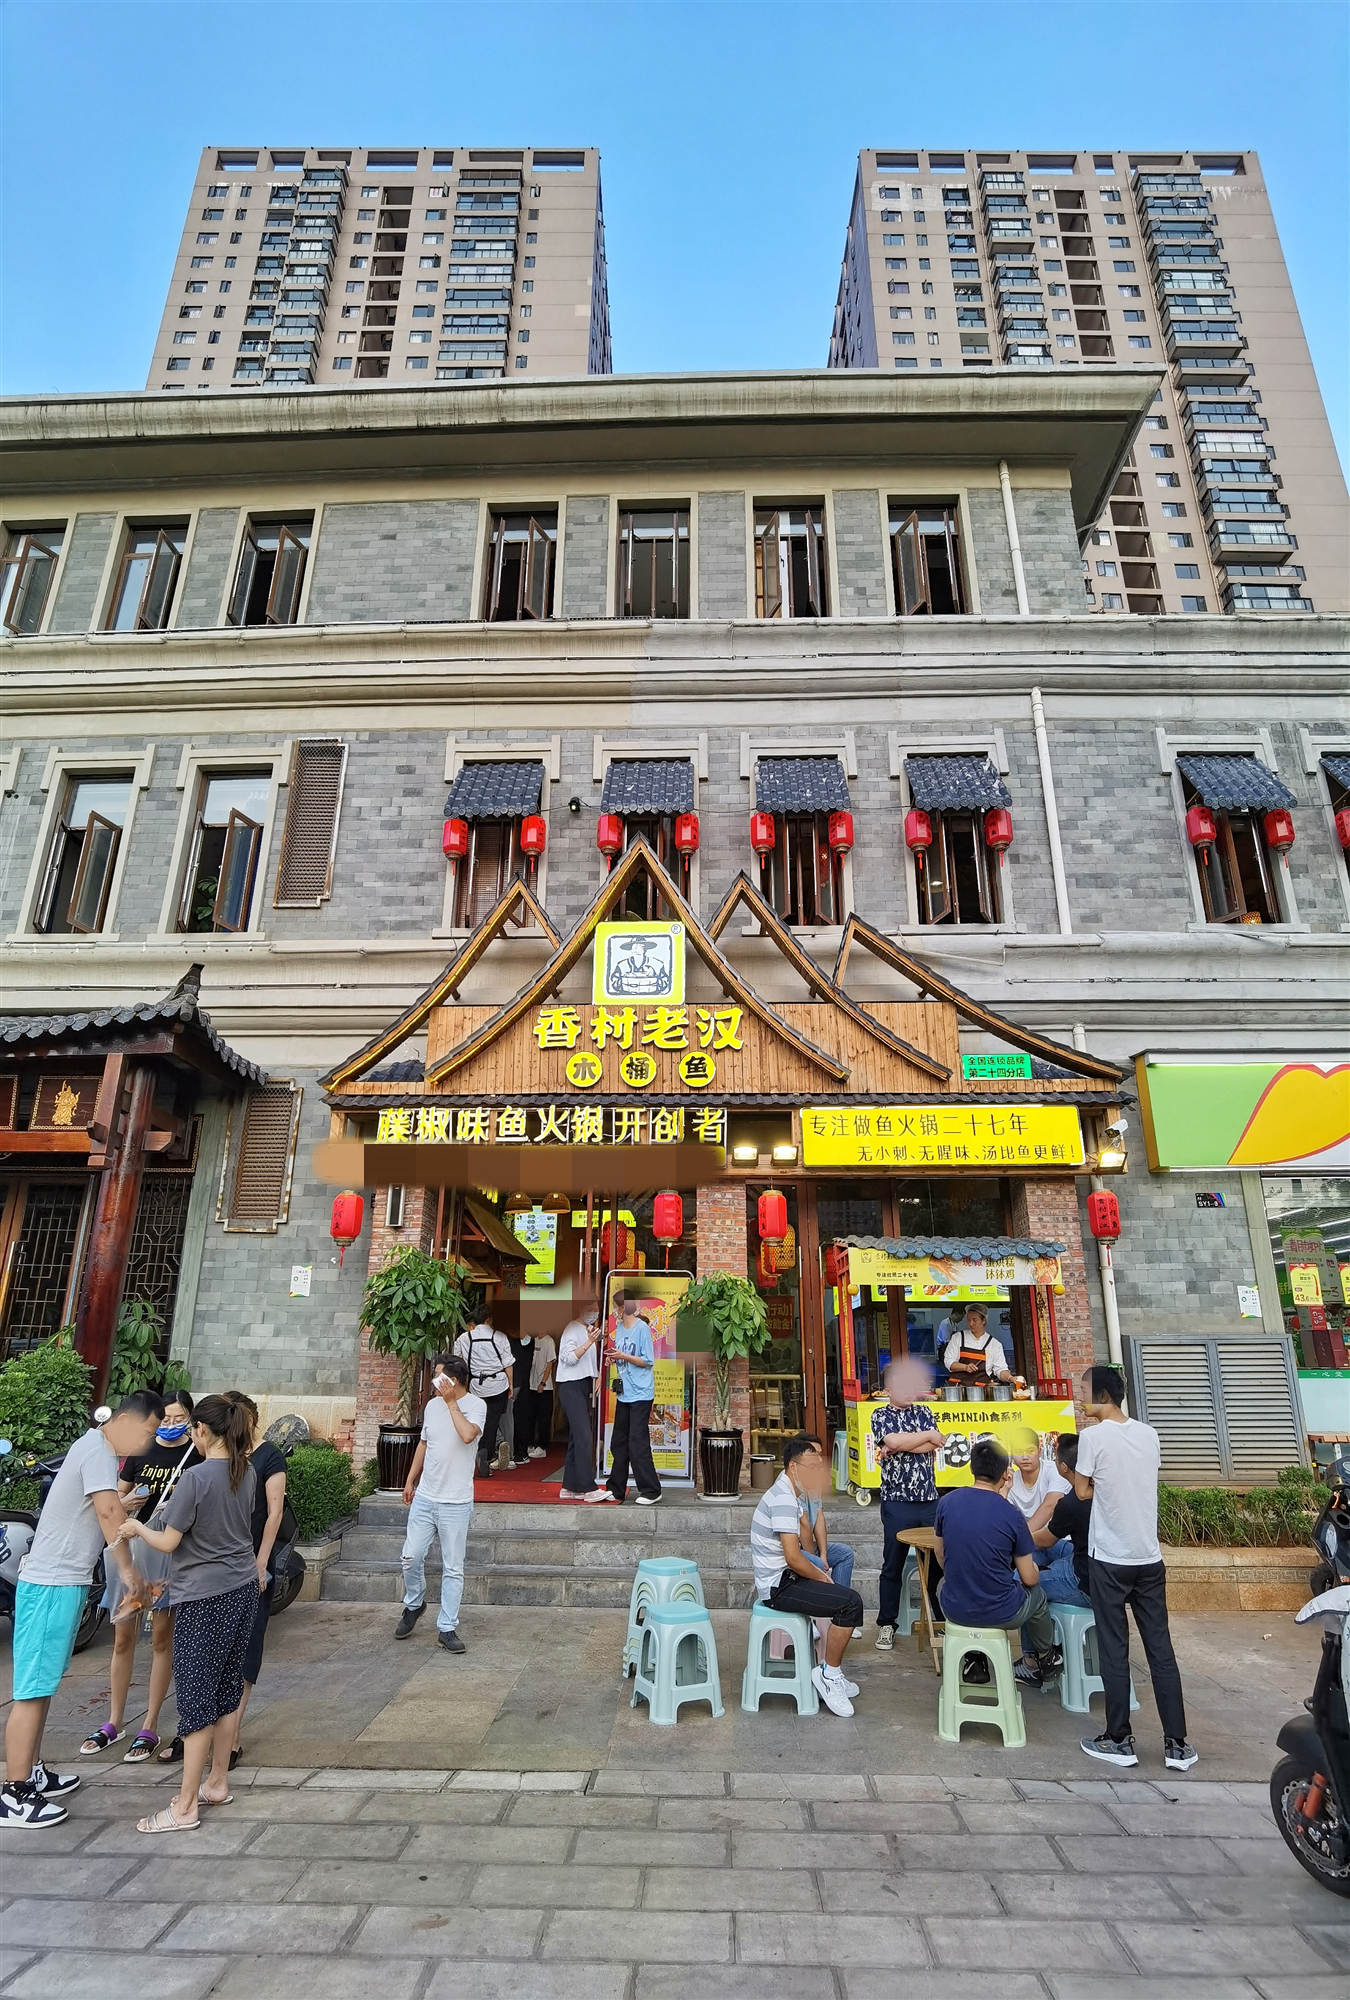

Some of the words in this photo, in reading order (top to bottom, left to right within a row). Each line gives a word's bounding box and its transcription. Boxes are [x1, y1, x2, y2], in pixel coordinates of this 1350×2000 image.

[533, 1006, 744, 1050] 香村老汉
[573, 1056, 709, 1081] 木桶鱼
[968, 1056, 1025, 1066] 全国连锁品牌
[968, 1068, 1026, 1078] 第二十四分店
[375, 1105, 726, 1144] 藤椒味鱼火锅开创者
[809, 1113, 1029, 1137] 专注做鱼火锅二十七年
[985, 1268, 1015, 1279] 钵钵鸡
[933, 1411, 1023, 1423] 经典MINI小食系列
[140, 1464, 170, 1481] Enjoy
